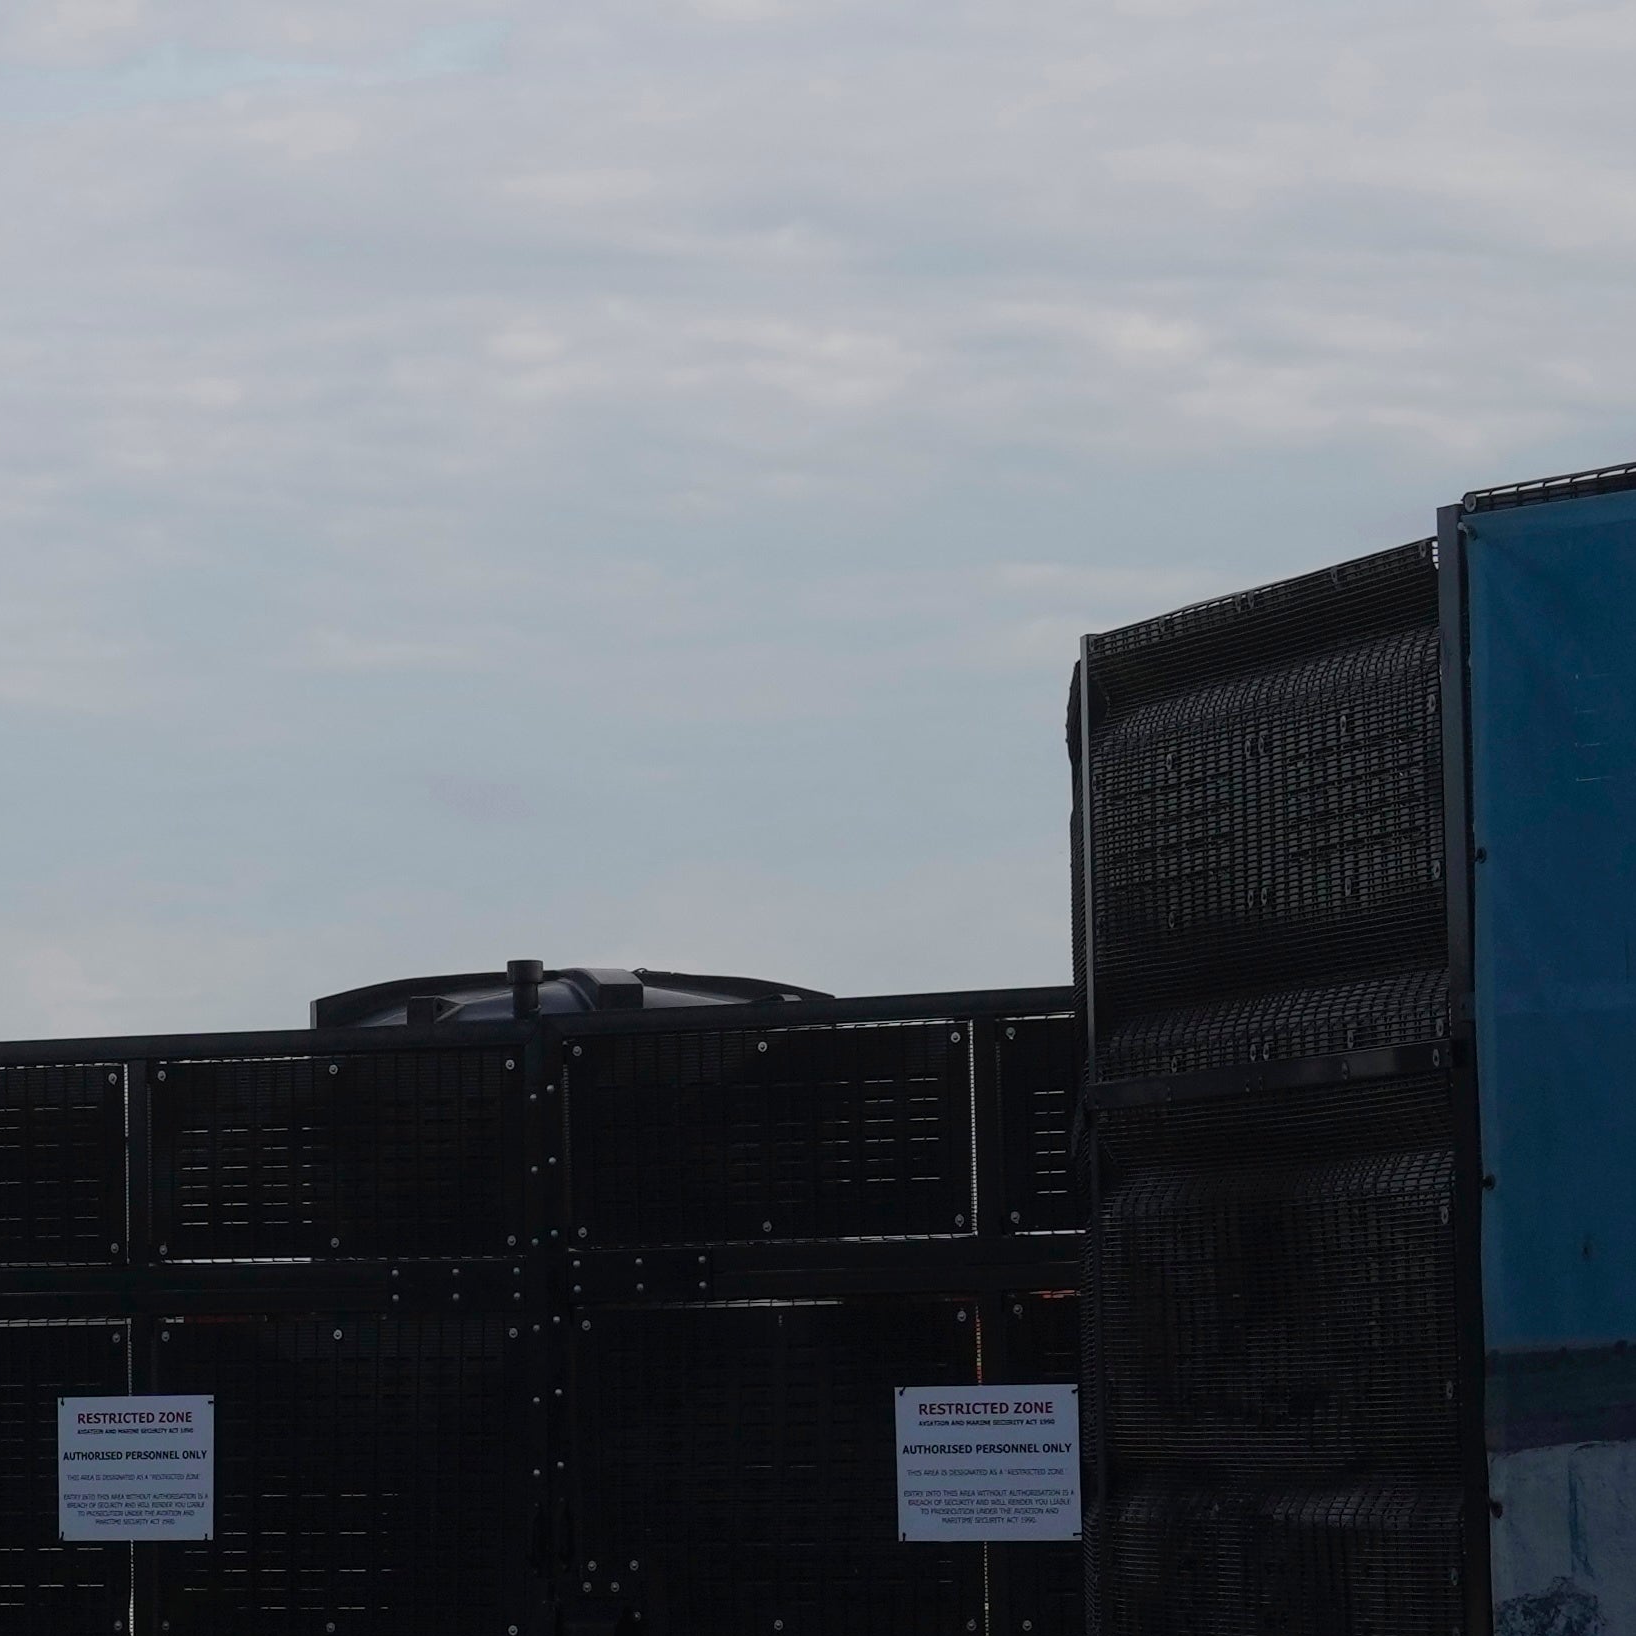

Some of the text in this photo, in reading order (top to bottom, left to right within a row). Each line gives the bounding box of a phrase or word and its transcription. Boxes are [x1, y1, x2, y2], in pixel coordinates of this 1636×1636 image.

[919, 1402, 1053, 1414] RESTRICTED ZONE
[78, 1412, 192, 1423] RESTRICTED ZONE
[903, 1444, 1072, 1454] AUTHORISED PERSONNEL ONLY
[63, 1450, 207, 1460] AUTHORISED PERSONNEL ONLY
